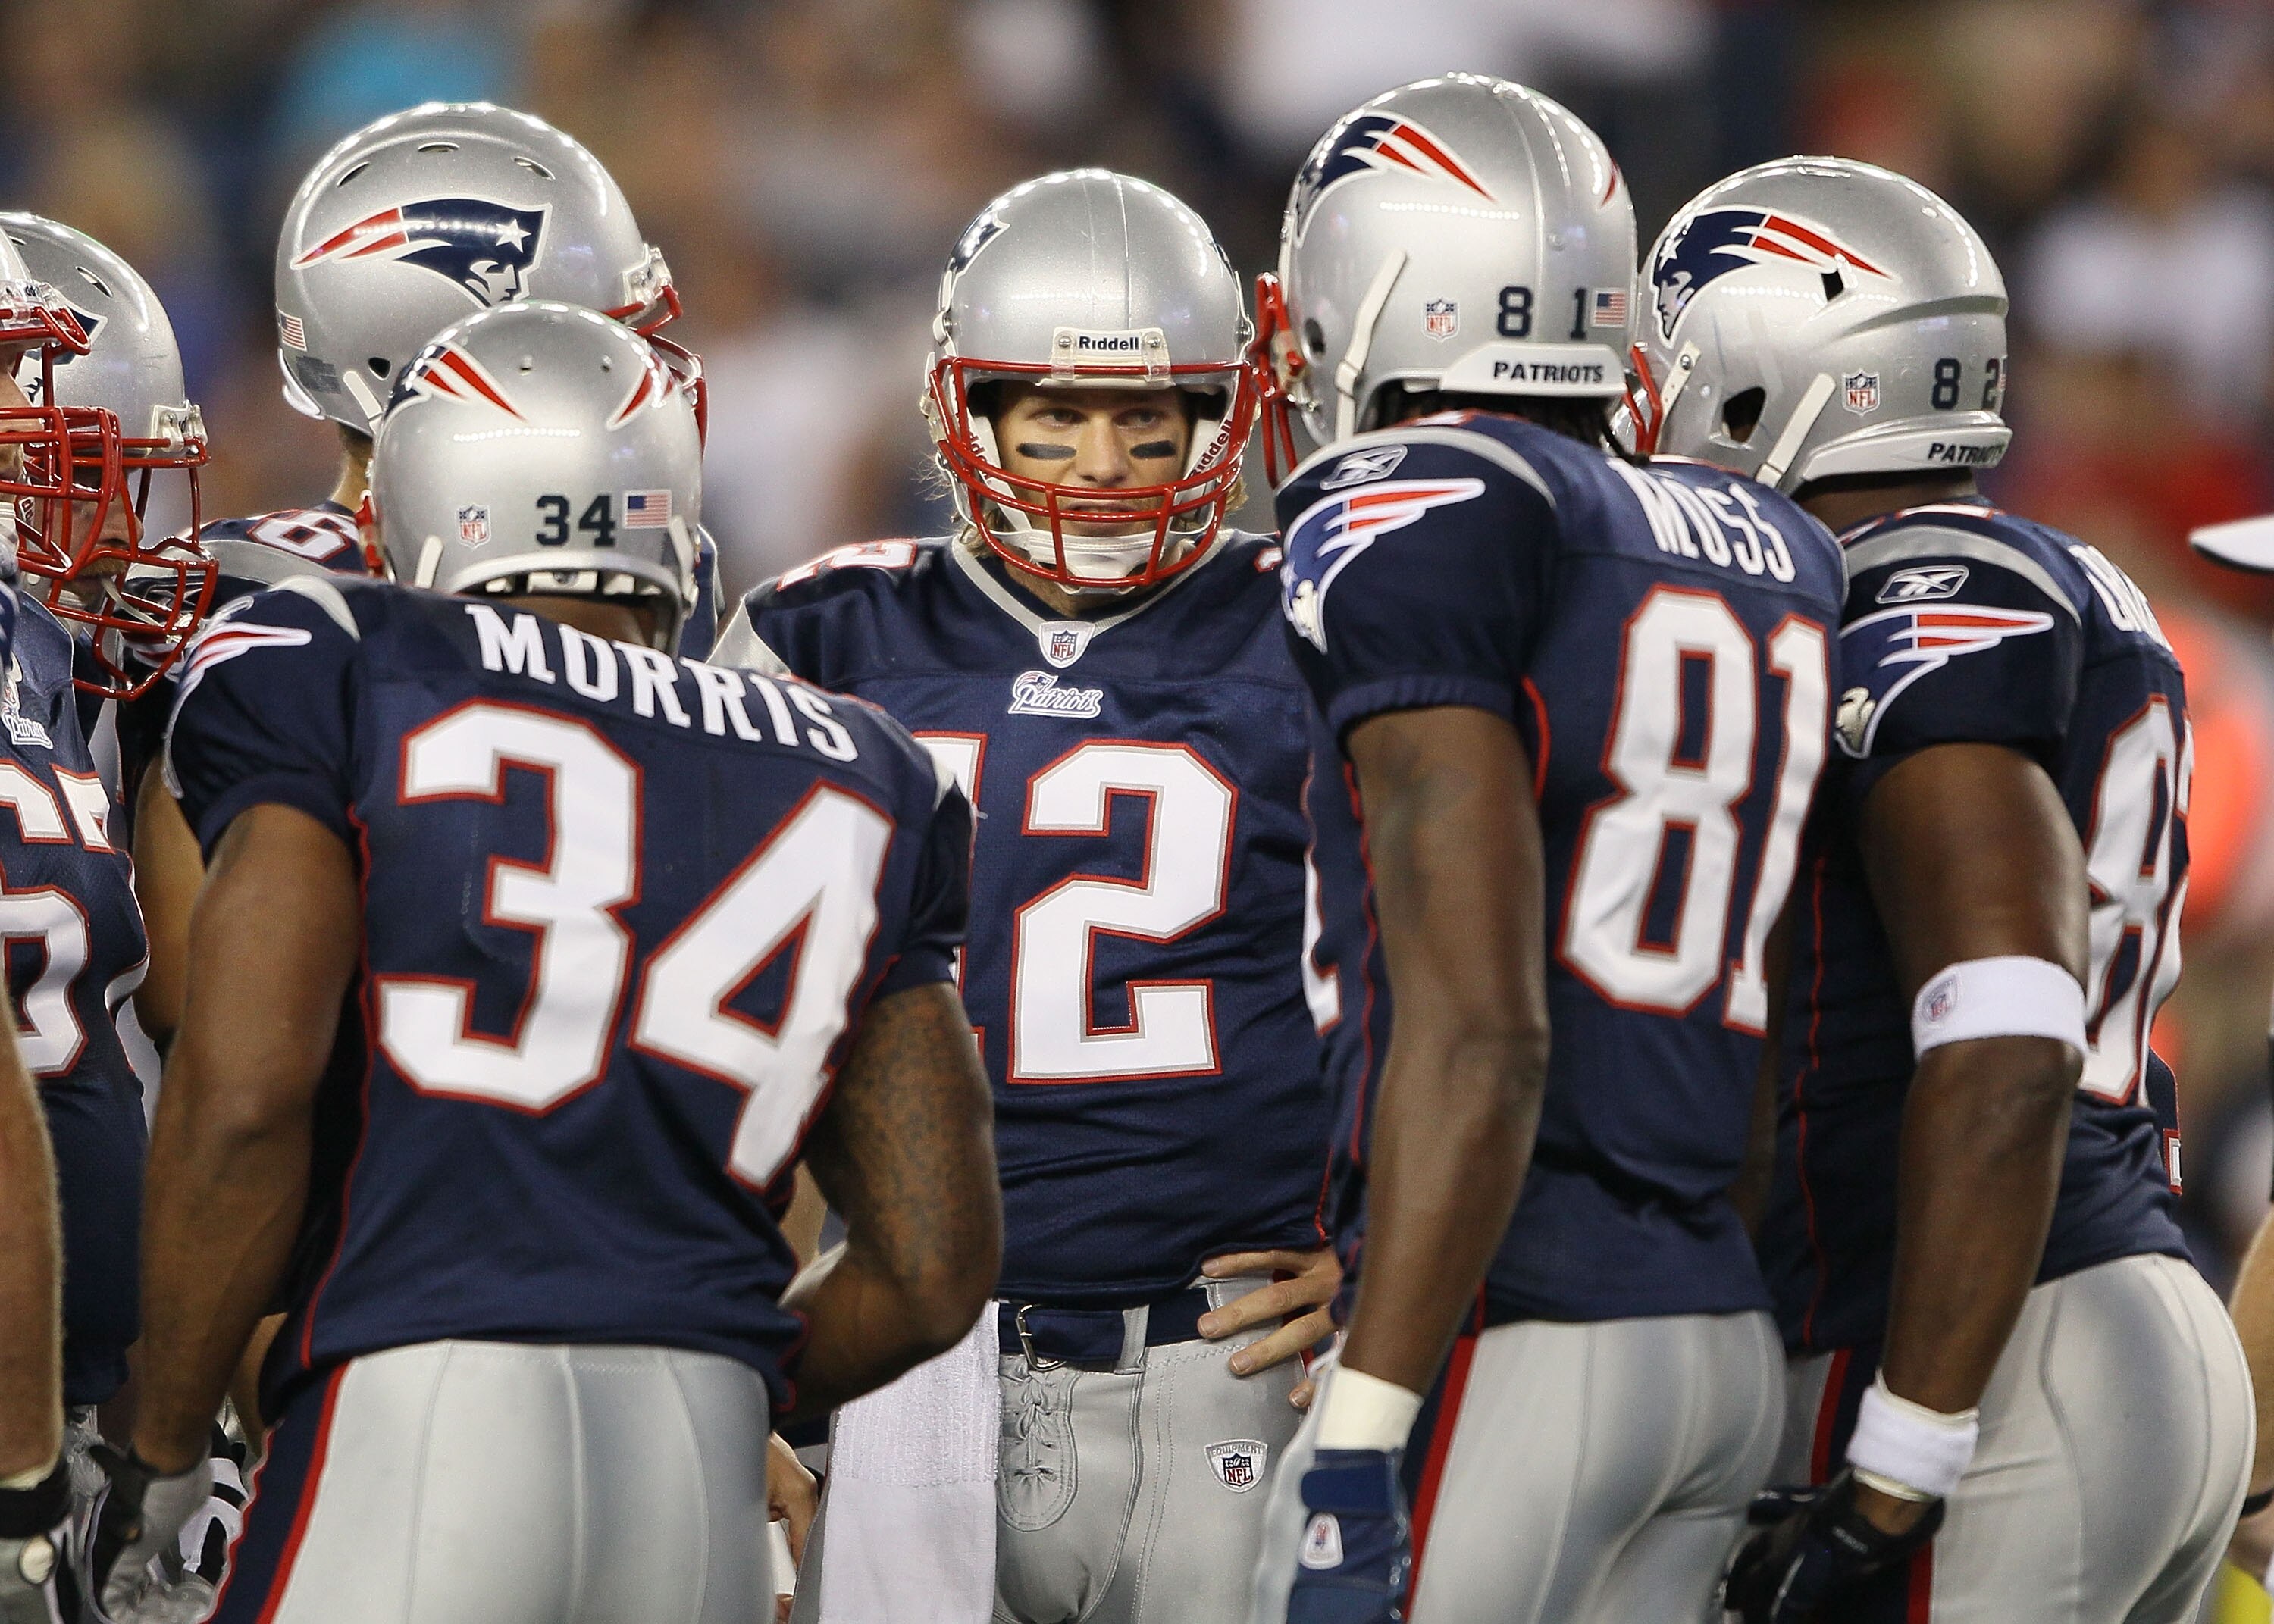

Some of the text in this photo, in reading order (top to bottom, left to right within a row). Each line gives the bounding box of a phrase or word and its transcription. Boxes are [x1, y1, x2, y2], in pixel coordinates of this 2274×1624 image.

[1078, 335, 1139, 351] Riddell
[1493, 361, 1603, 383] PATRIOTS
[1848, 390, 1876, 408] NFL
[1928, 443, 2005, 465] PATRIOT
[536, 494, 617, 548] 34
[1606, 456, 1796, 583] MOSS
[1053, 643, 1073, 659] NFL
[465, 603, 859, 762] MORRIS
[1008, 679, 1104, 718] Patriots
[1555, 583, 1832, 1039] 81
[373, 697, 896, 1191] 34
[1226, 1468, 1251, 1484] NFL
